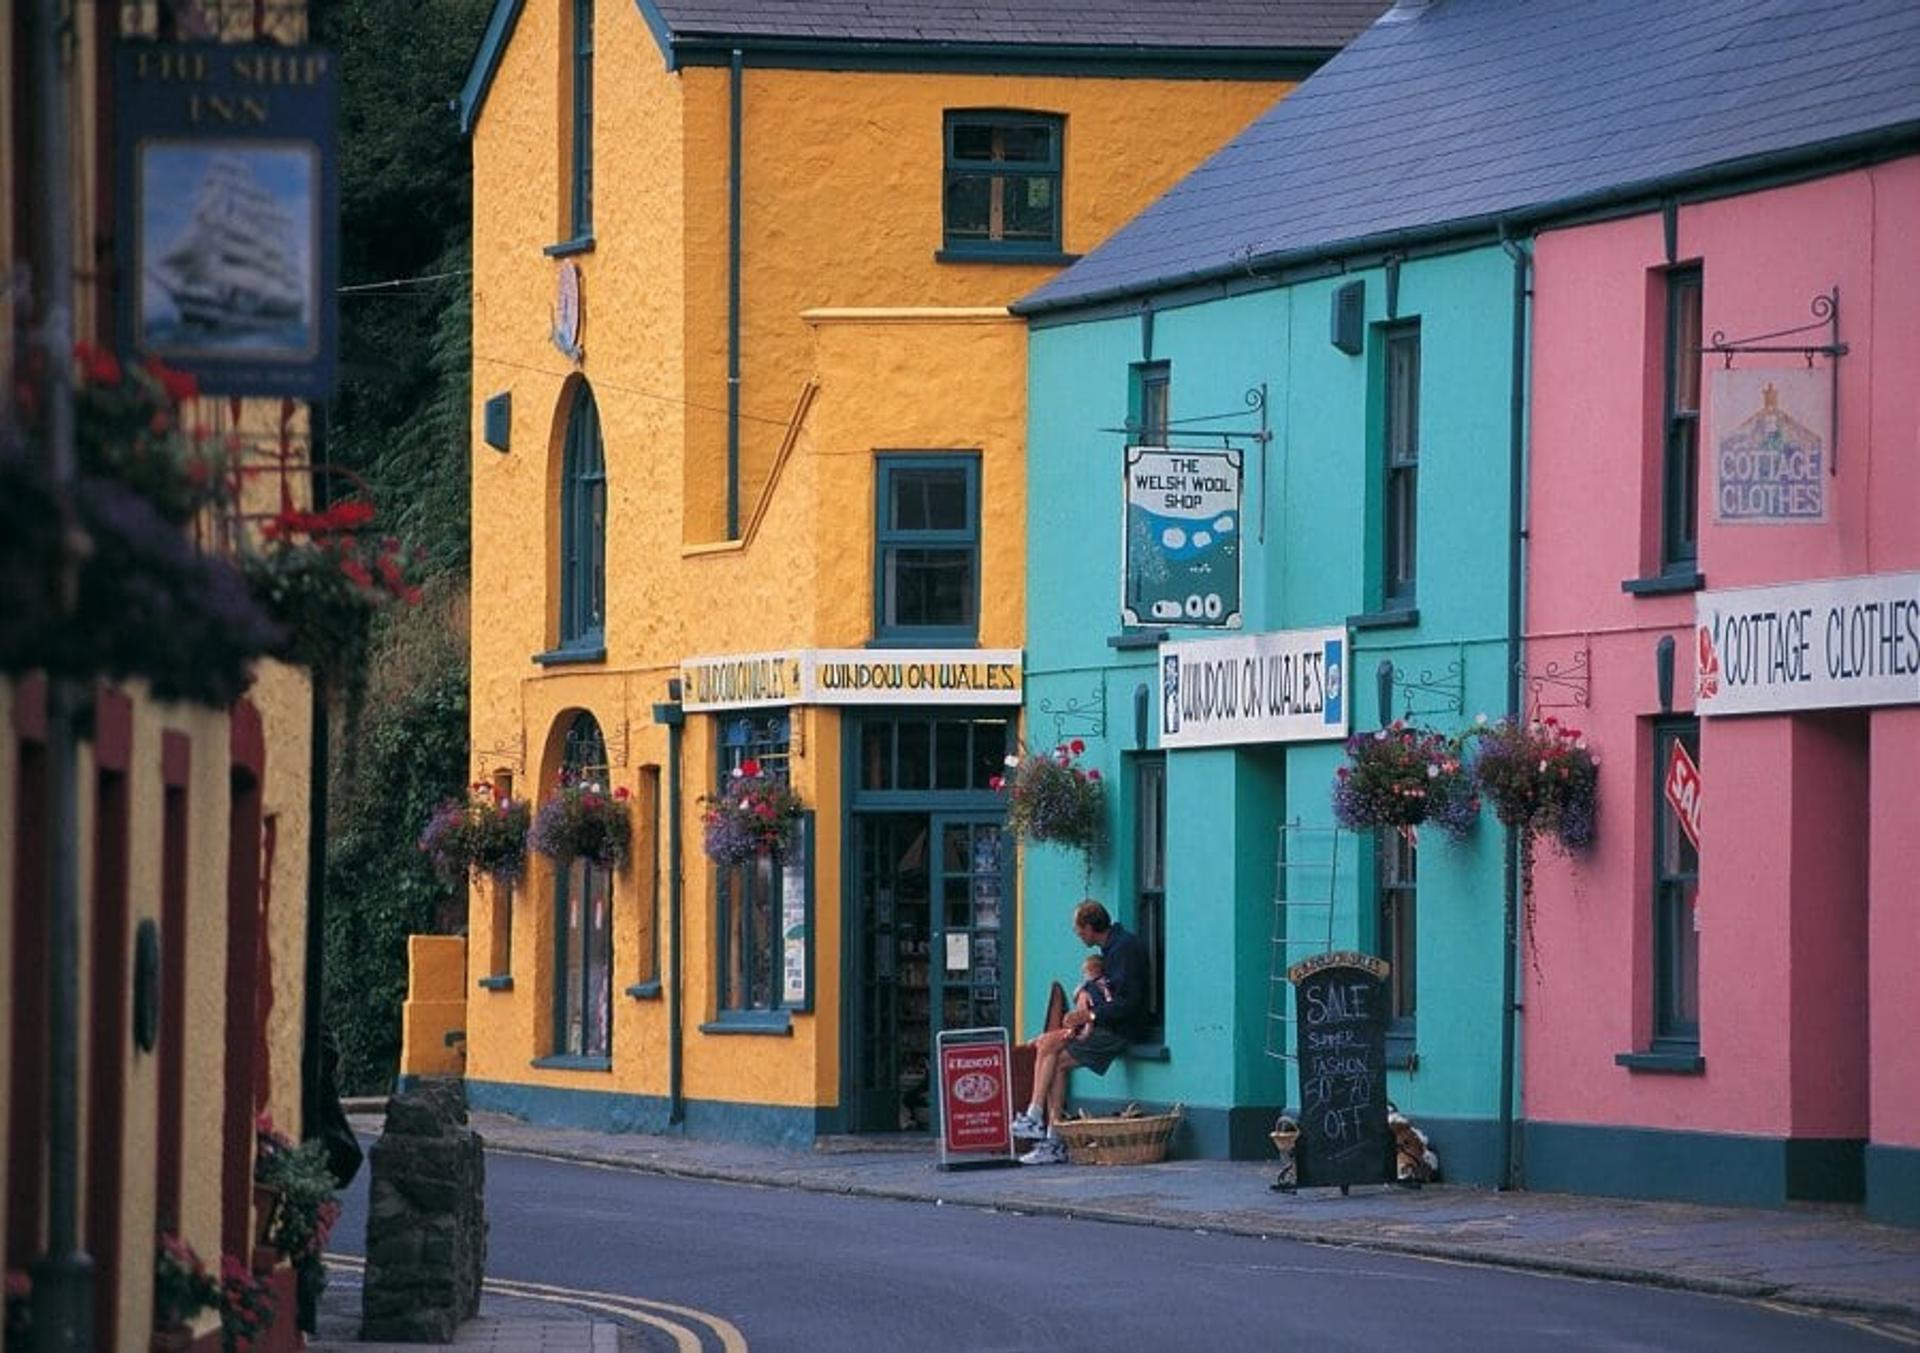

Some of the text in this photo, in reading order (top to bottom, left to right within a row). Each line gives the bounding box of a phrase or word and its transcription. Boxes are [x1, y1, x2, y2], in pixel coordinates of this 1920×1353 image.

[232, 53, 328, 84] SHIP
[189, 94, 268, 124] INN
[1171, 459, 1200, 473] THE
[1721, 450, 1820, 481] COTTAGE
[1137, 476, 1232, 492] WELSH WOOL
[1722, 483, 1821, 514] CLOTHES
[1164, 494, 1202, 509] SHOP
[1724, 599, 1920, 686] COTTAGE CLOTHES
[822, 663, 1014, 690] WINDOW ON WALES
[1182, 652, 1324, 723] WINDOW ON WALES
[1672, 760, 1700, 838] SAL
[1307, 982, 1369, 1024] SALE
[1324, 1104, 1369, 1140] OFF
